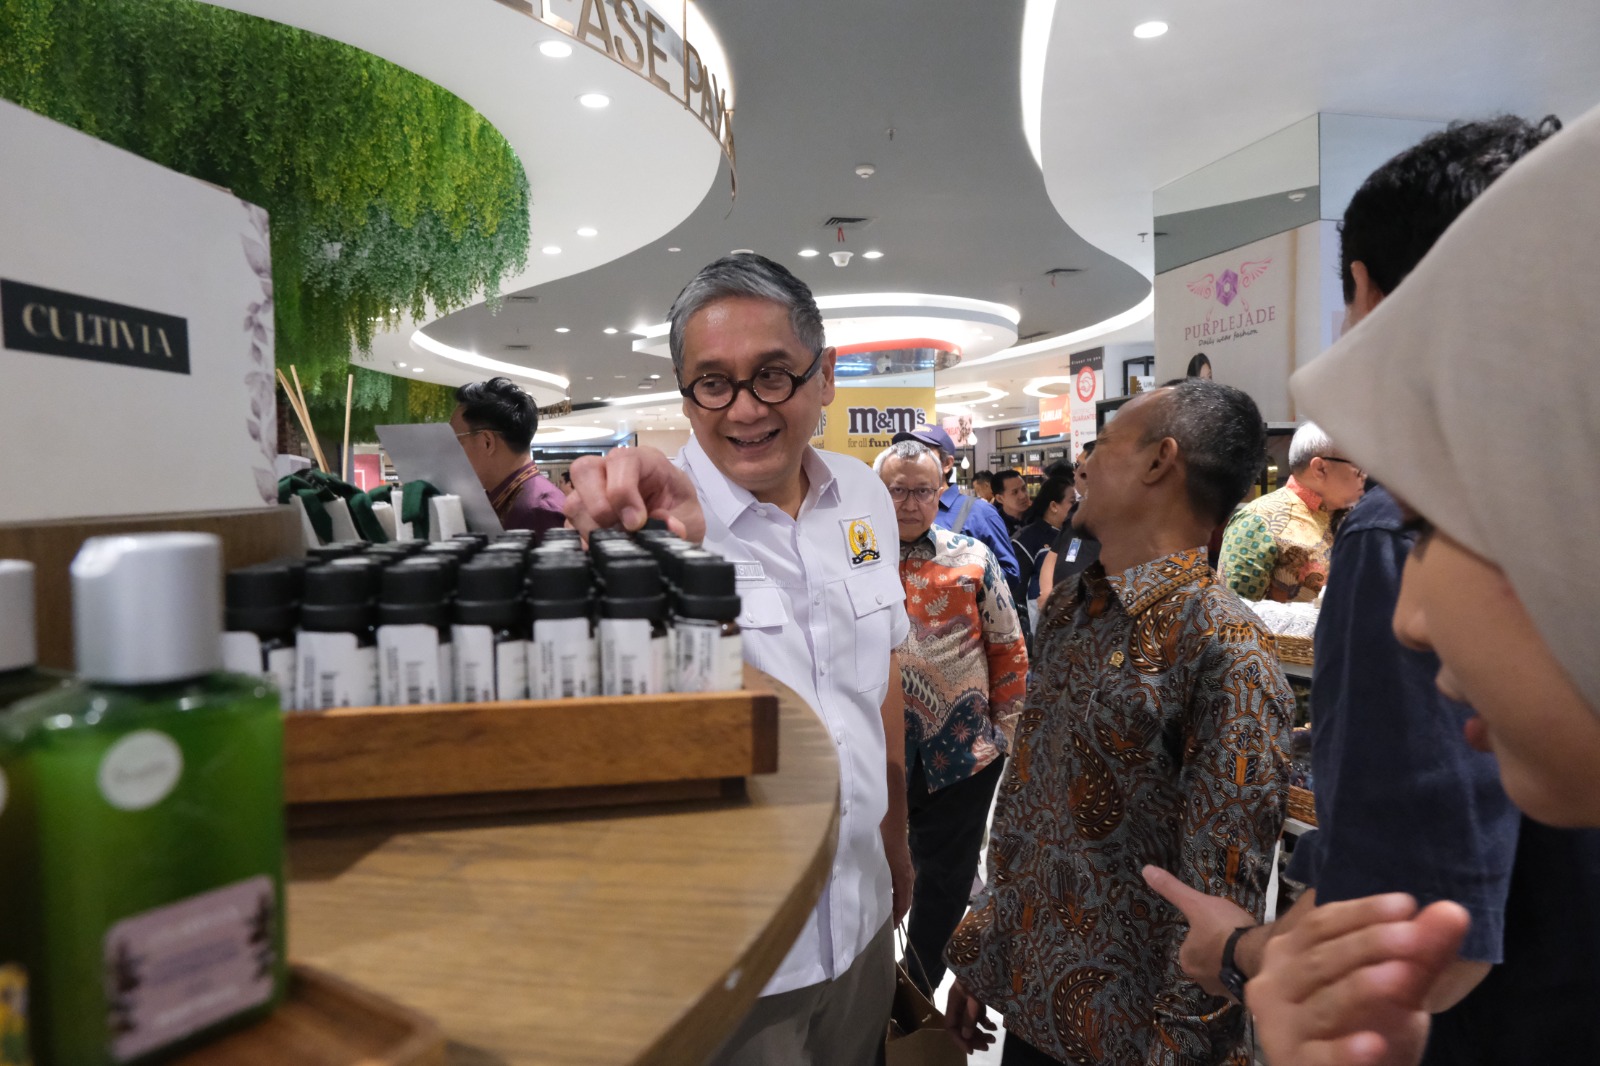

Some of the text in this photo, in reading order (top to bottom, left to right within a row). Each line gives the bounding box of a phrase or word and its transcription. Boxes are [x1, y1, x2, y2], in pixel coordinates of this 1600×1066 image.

[1184, 305, 1276, 341] PURPLEJADE
[1198, 329, 1258, 347] Daily wear fashion
[869, 437, 894, 448] fun
